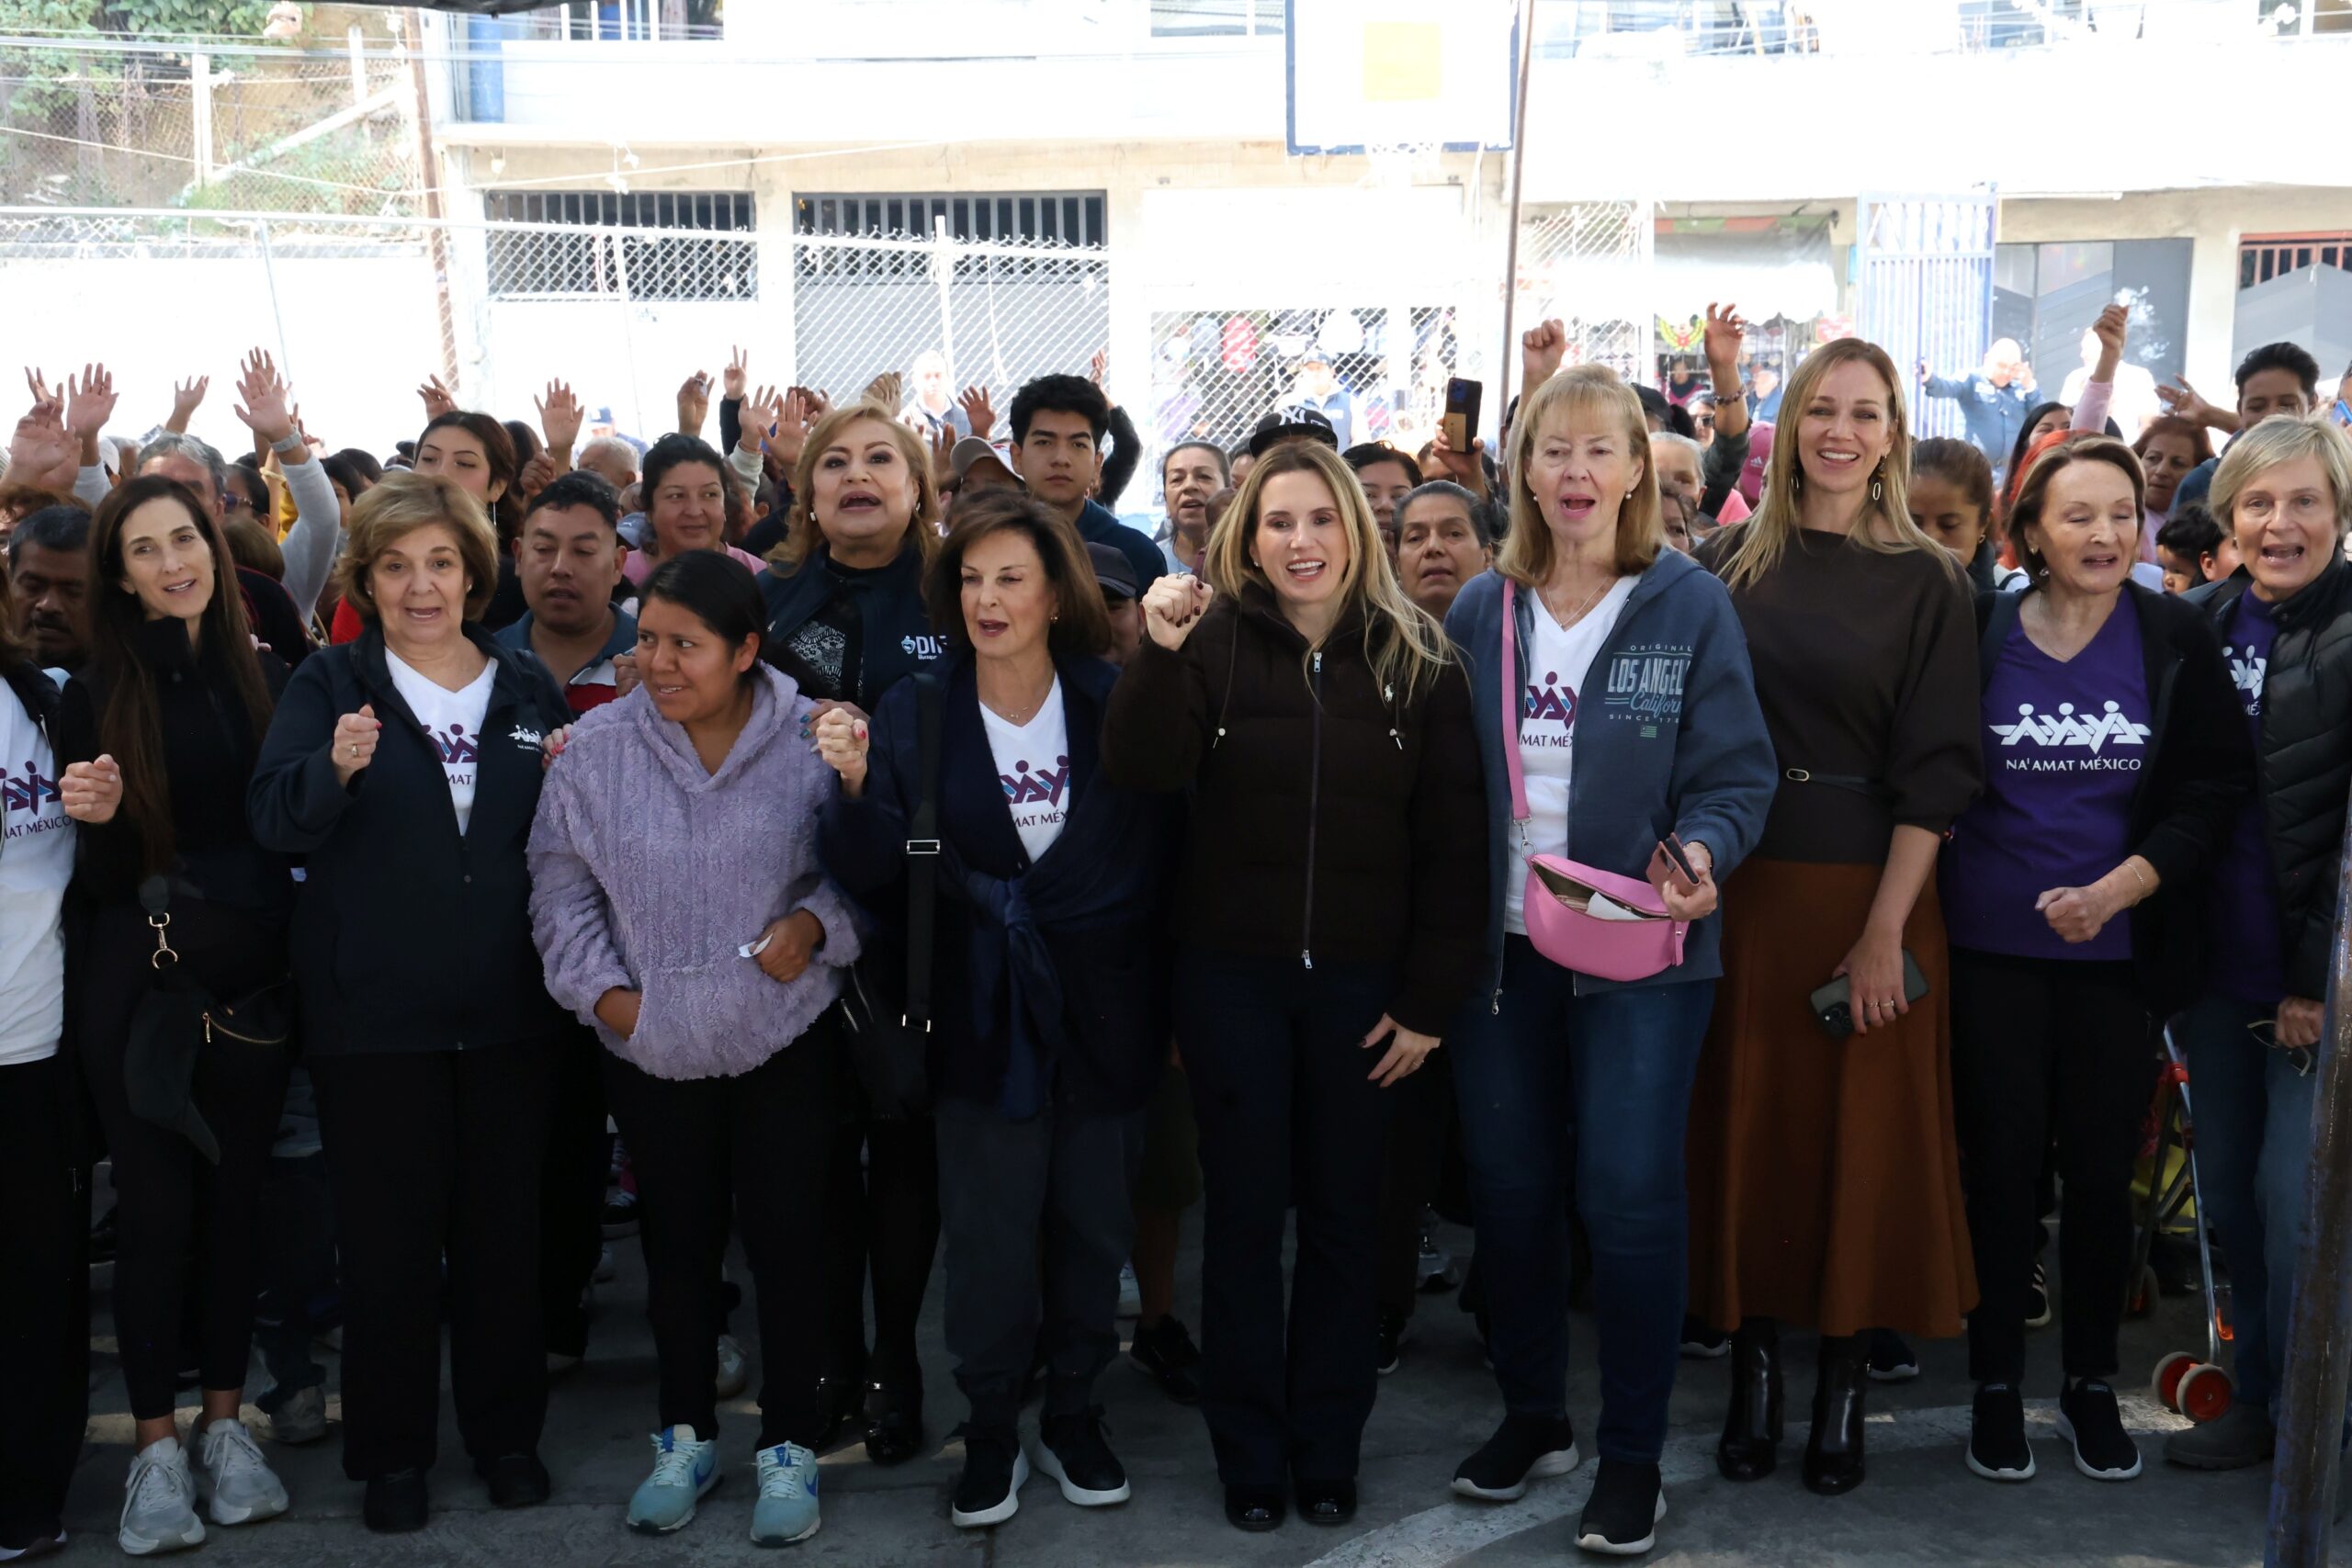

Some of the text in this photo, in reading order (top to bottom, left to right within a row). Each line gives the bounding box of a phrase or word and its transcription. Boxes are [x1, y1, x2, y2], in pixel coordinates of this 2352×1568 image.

[1630, 644, 1692, 652] ORIGINAL
[1607, 657, 1691, 695] LOS ANGEL
[1610, 714, 1650, 722] SINCE
[2006, 755, 2142, 772] NA'AMAT MÉXICO
[26, 815, 72, 836] MÉXICO
